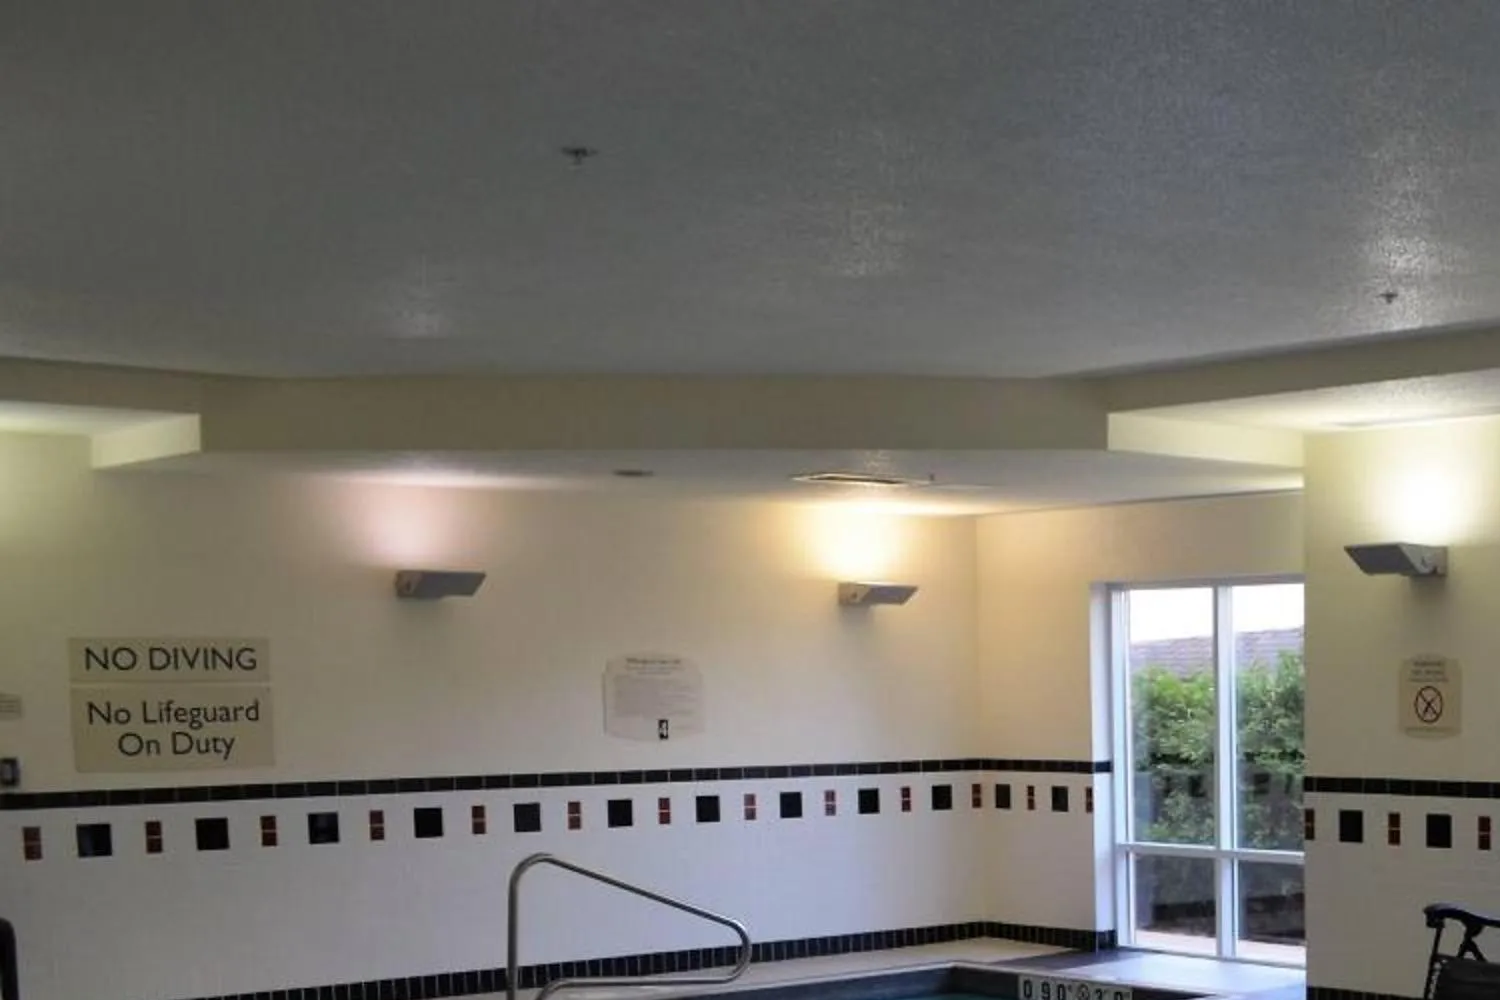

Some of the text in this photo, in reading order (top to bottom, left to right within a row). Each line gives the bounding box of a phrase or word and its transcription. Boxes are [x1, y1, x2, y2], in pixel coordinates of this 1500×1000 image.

[84, 646, 258, 671] NO DIVING
[87, 698, 261, 730] No Lifeguard
[117, 731, 236, 761] On Duty
